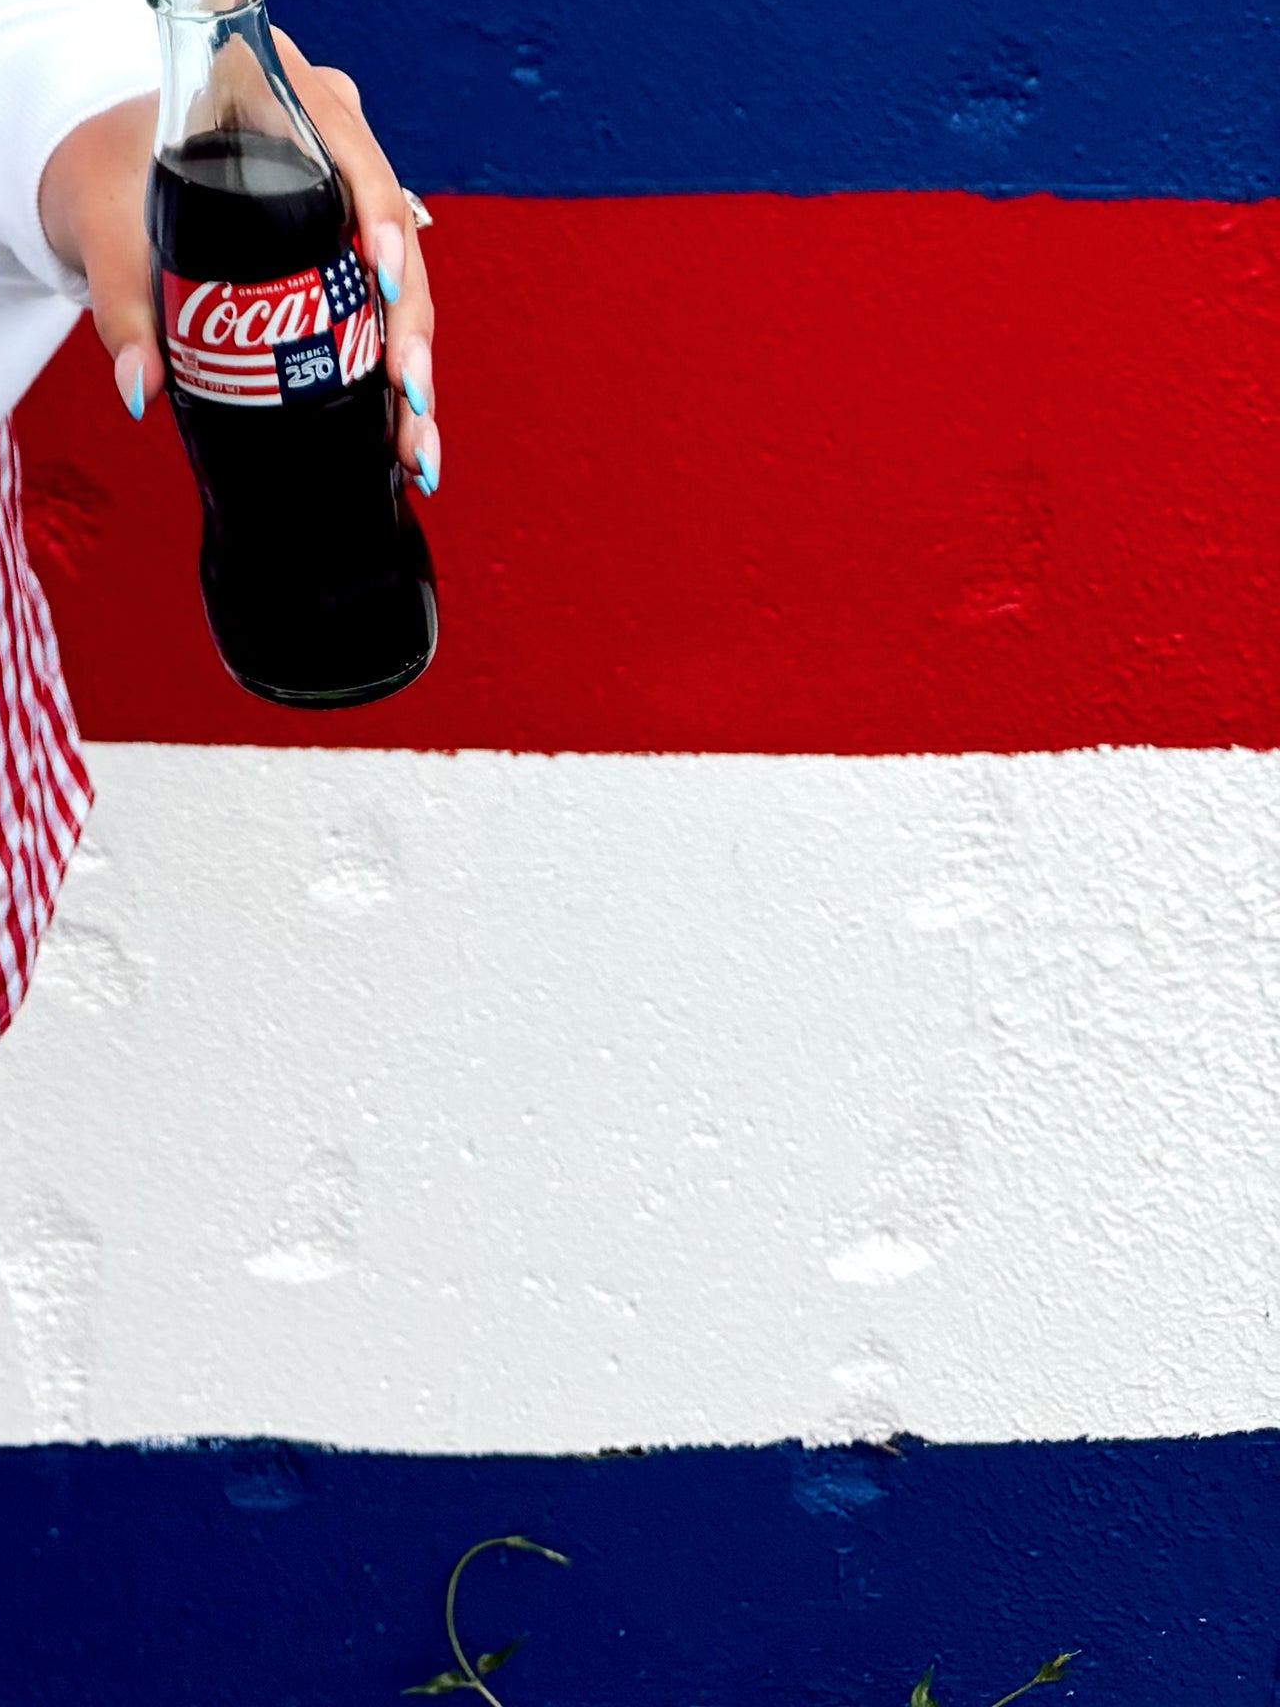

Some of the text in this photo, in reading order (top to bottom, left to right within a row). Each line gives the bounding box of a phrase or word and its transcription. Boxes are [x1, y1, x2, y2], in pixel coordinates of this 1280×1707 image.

[238, 283, 285, 298] ORIGINAL
[284, 345, 331, 365] AMERICA
[285, 356, 335, 389] 250
